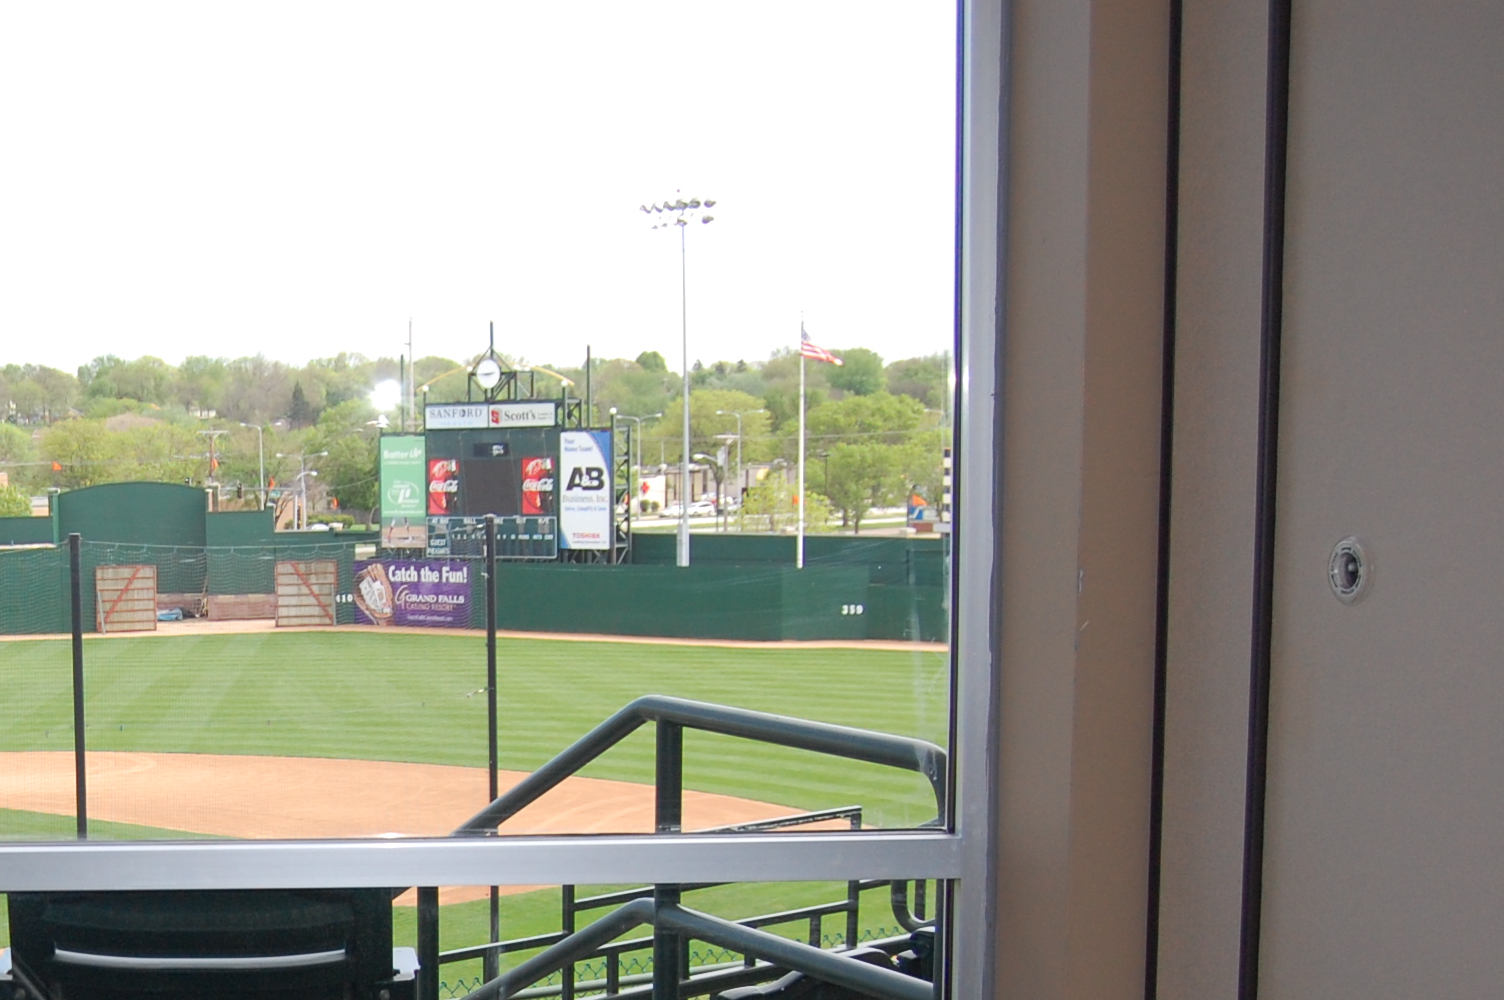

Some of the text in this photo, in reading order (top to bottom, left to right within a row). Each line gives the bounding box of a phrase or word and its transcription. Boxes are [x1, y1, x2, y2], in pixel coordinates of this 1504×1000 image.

[429, 407, 483, 418] SANFORD
[503, 409, 536, 421] Scott's
[388, 565, 468, 583] Catch the Fun!
[406, 594, 465, 604] GRAND FALLS
